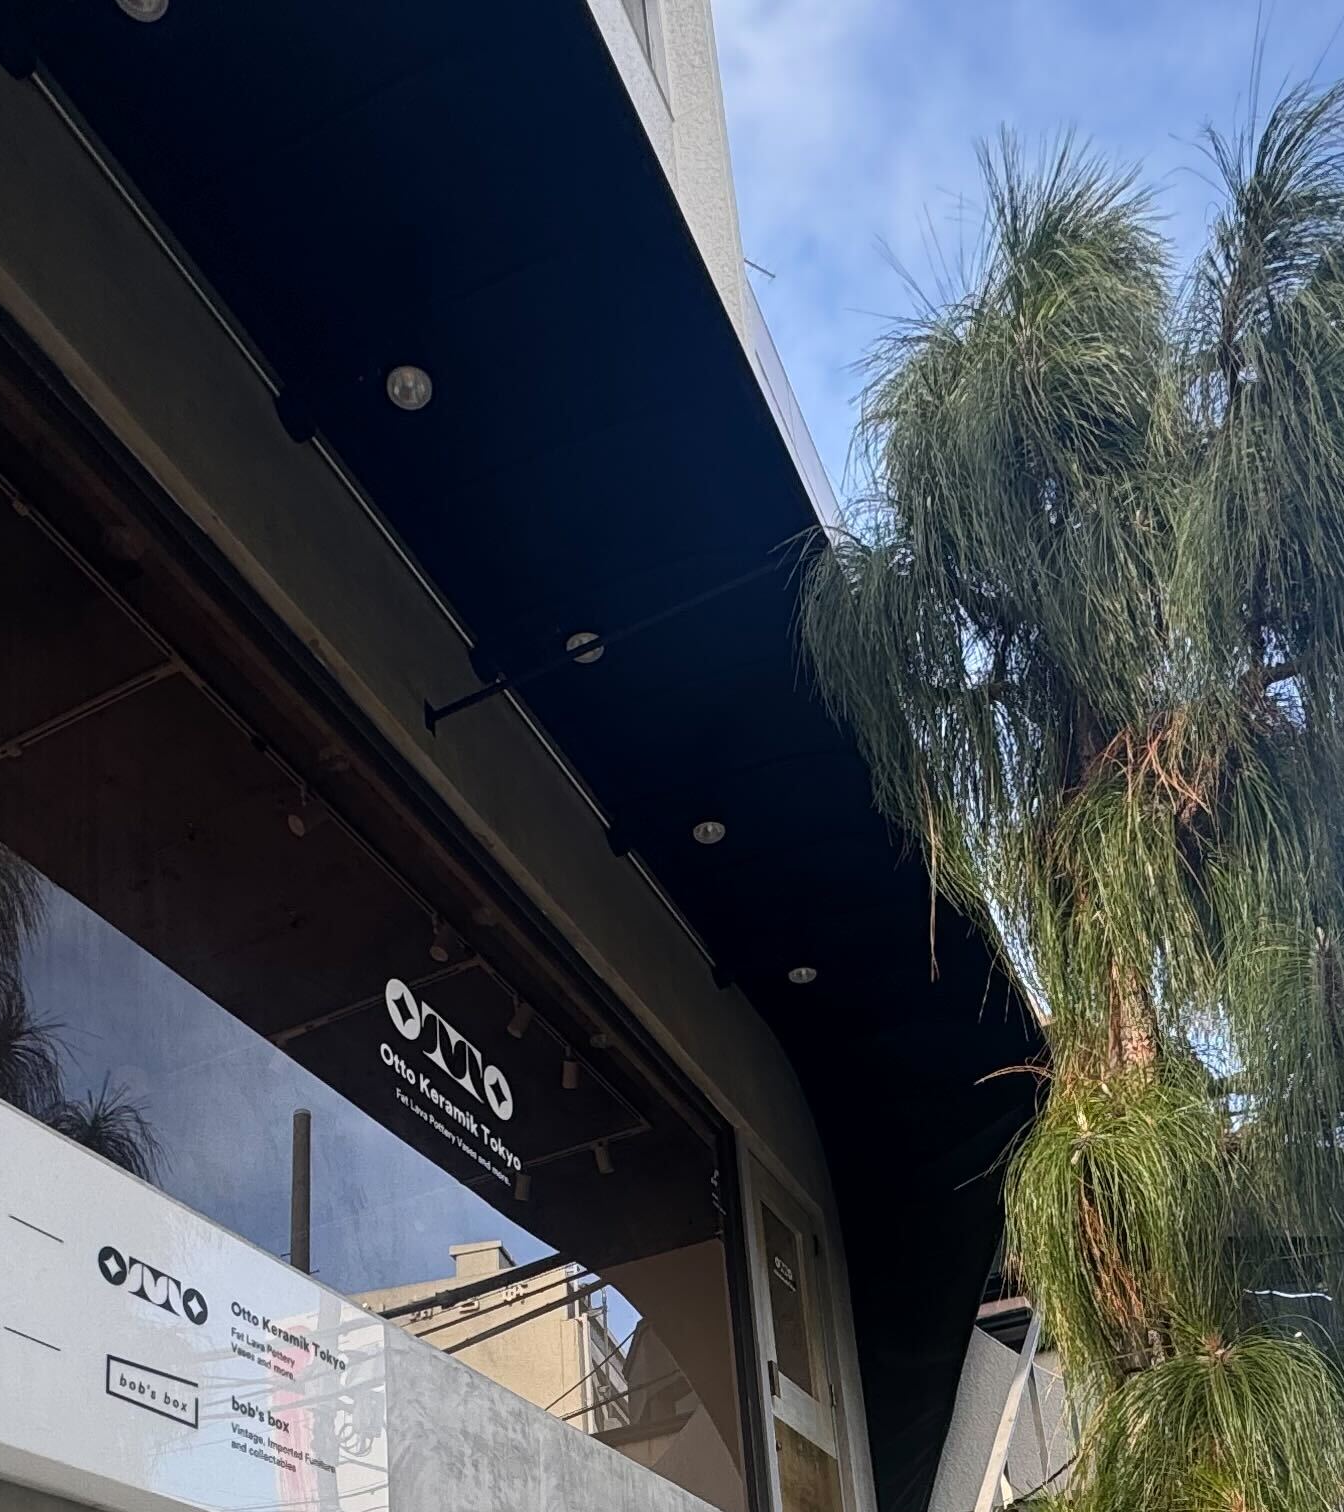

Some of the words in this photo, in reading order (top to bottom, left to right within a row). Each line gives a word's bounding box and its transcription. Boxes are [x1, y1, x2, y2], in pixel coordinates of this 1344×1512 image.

[385, 978, 513, 1121] OTTO
[380, 1043, 416, 1085] Otto
[419, 1072, 479, 1137] Keramik
[480, 1124, 521, 1171] Tokyo
[410, 1098, 428, 1121] Lava
[429, 1114, 456, 1144] Pottery
[98, 1246, 209, 1325] OTTO
[231, 1301, 260, 1326] Otto
[262, 1316, 311, 1353] Keramik
[312, 1341, 346, 1371] Tokyo
[231, 1327, 244, 1342] Fat
[246, 1334, 265, 1352] Lava
[267, 1344, 295, 1368] Pottery
[231, 1342, 255, 1361] Vases
[257, 1356, 272, 1369] and
[119, 1373, 157, 1400] bob's
[163, 1392, 188, 1412] box
[231, 1395, 265, 1422] bob's
[267, 1410, 290, 1433] box
[231, 1440, 247, 1453] and
[249, 1448, 297, 1473] collectables
[267, 1438, 303, 1461] Imported
